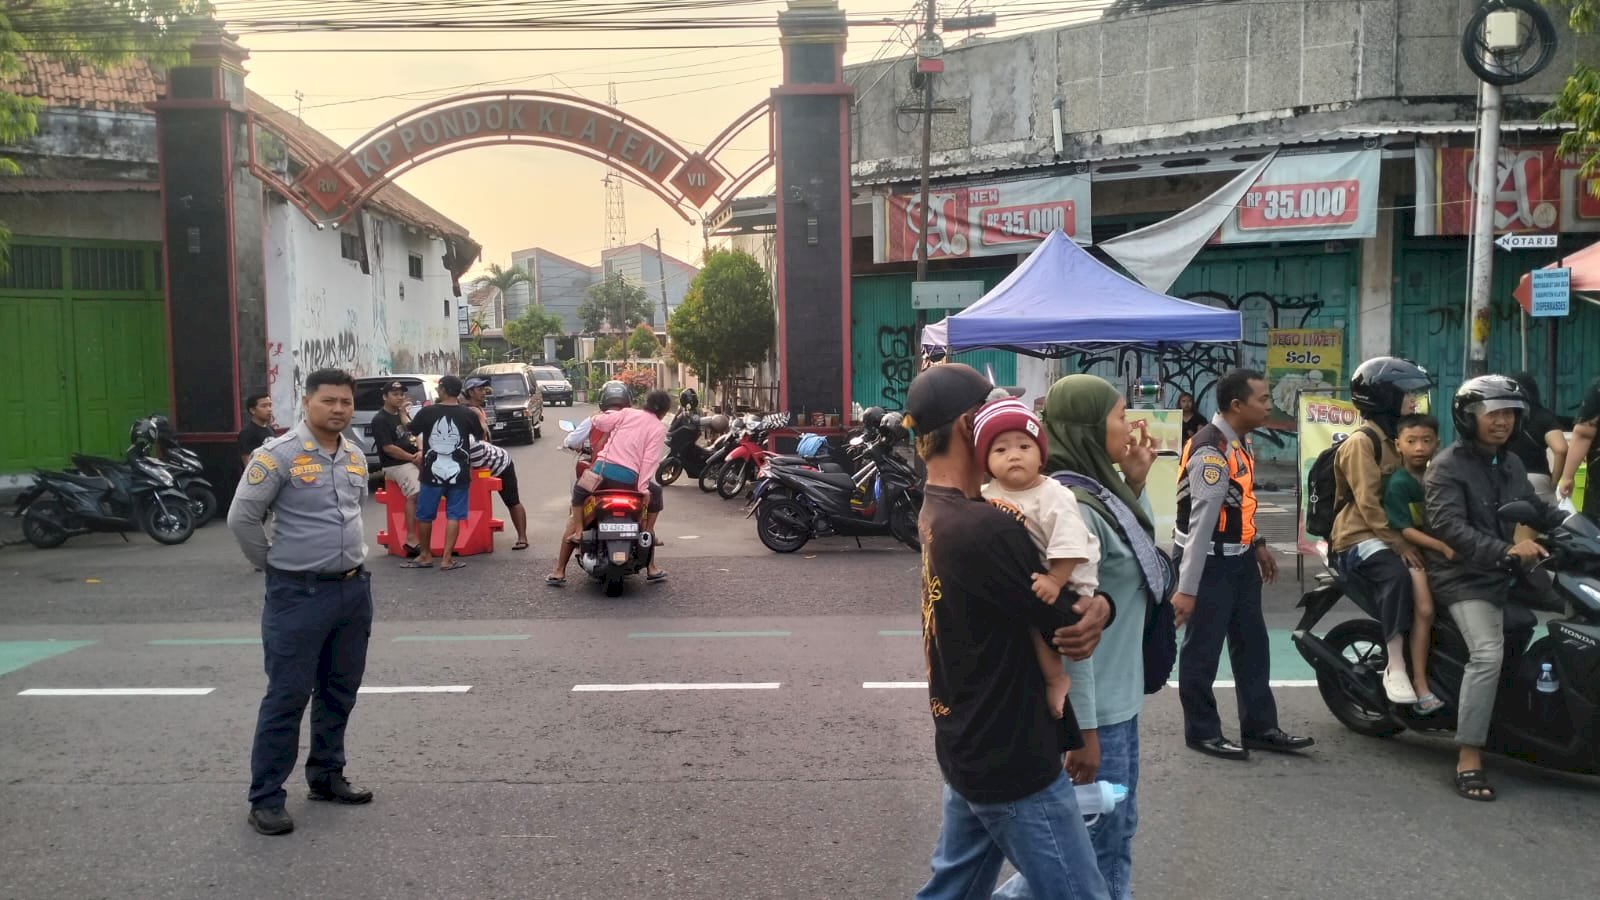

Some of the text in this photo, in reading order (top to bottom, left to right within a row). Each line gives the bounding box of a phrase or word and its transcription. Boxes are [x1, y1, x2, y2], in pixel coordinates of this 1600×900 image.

[355, 103, 665, 178] KP PONDOK KLATEN
[318, 179, 338, 192] RW
[686, 173, 706, 187] VII
[969, 190, 998, 204] NEW
[1246, 186, 1346, 221] RP 35.000
[987, 206, 1065, 236] RP 35.000
[1502, 236, 1556, 247] NOTARIS
[1286, 351, 1321, 364] Solo
[1305, 402, 1357, 425] SEGO
[1560, 626, 1596, 646] HONDA
